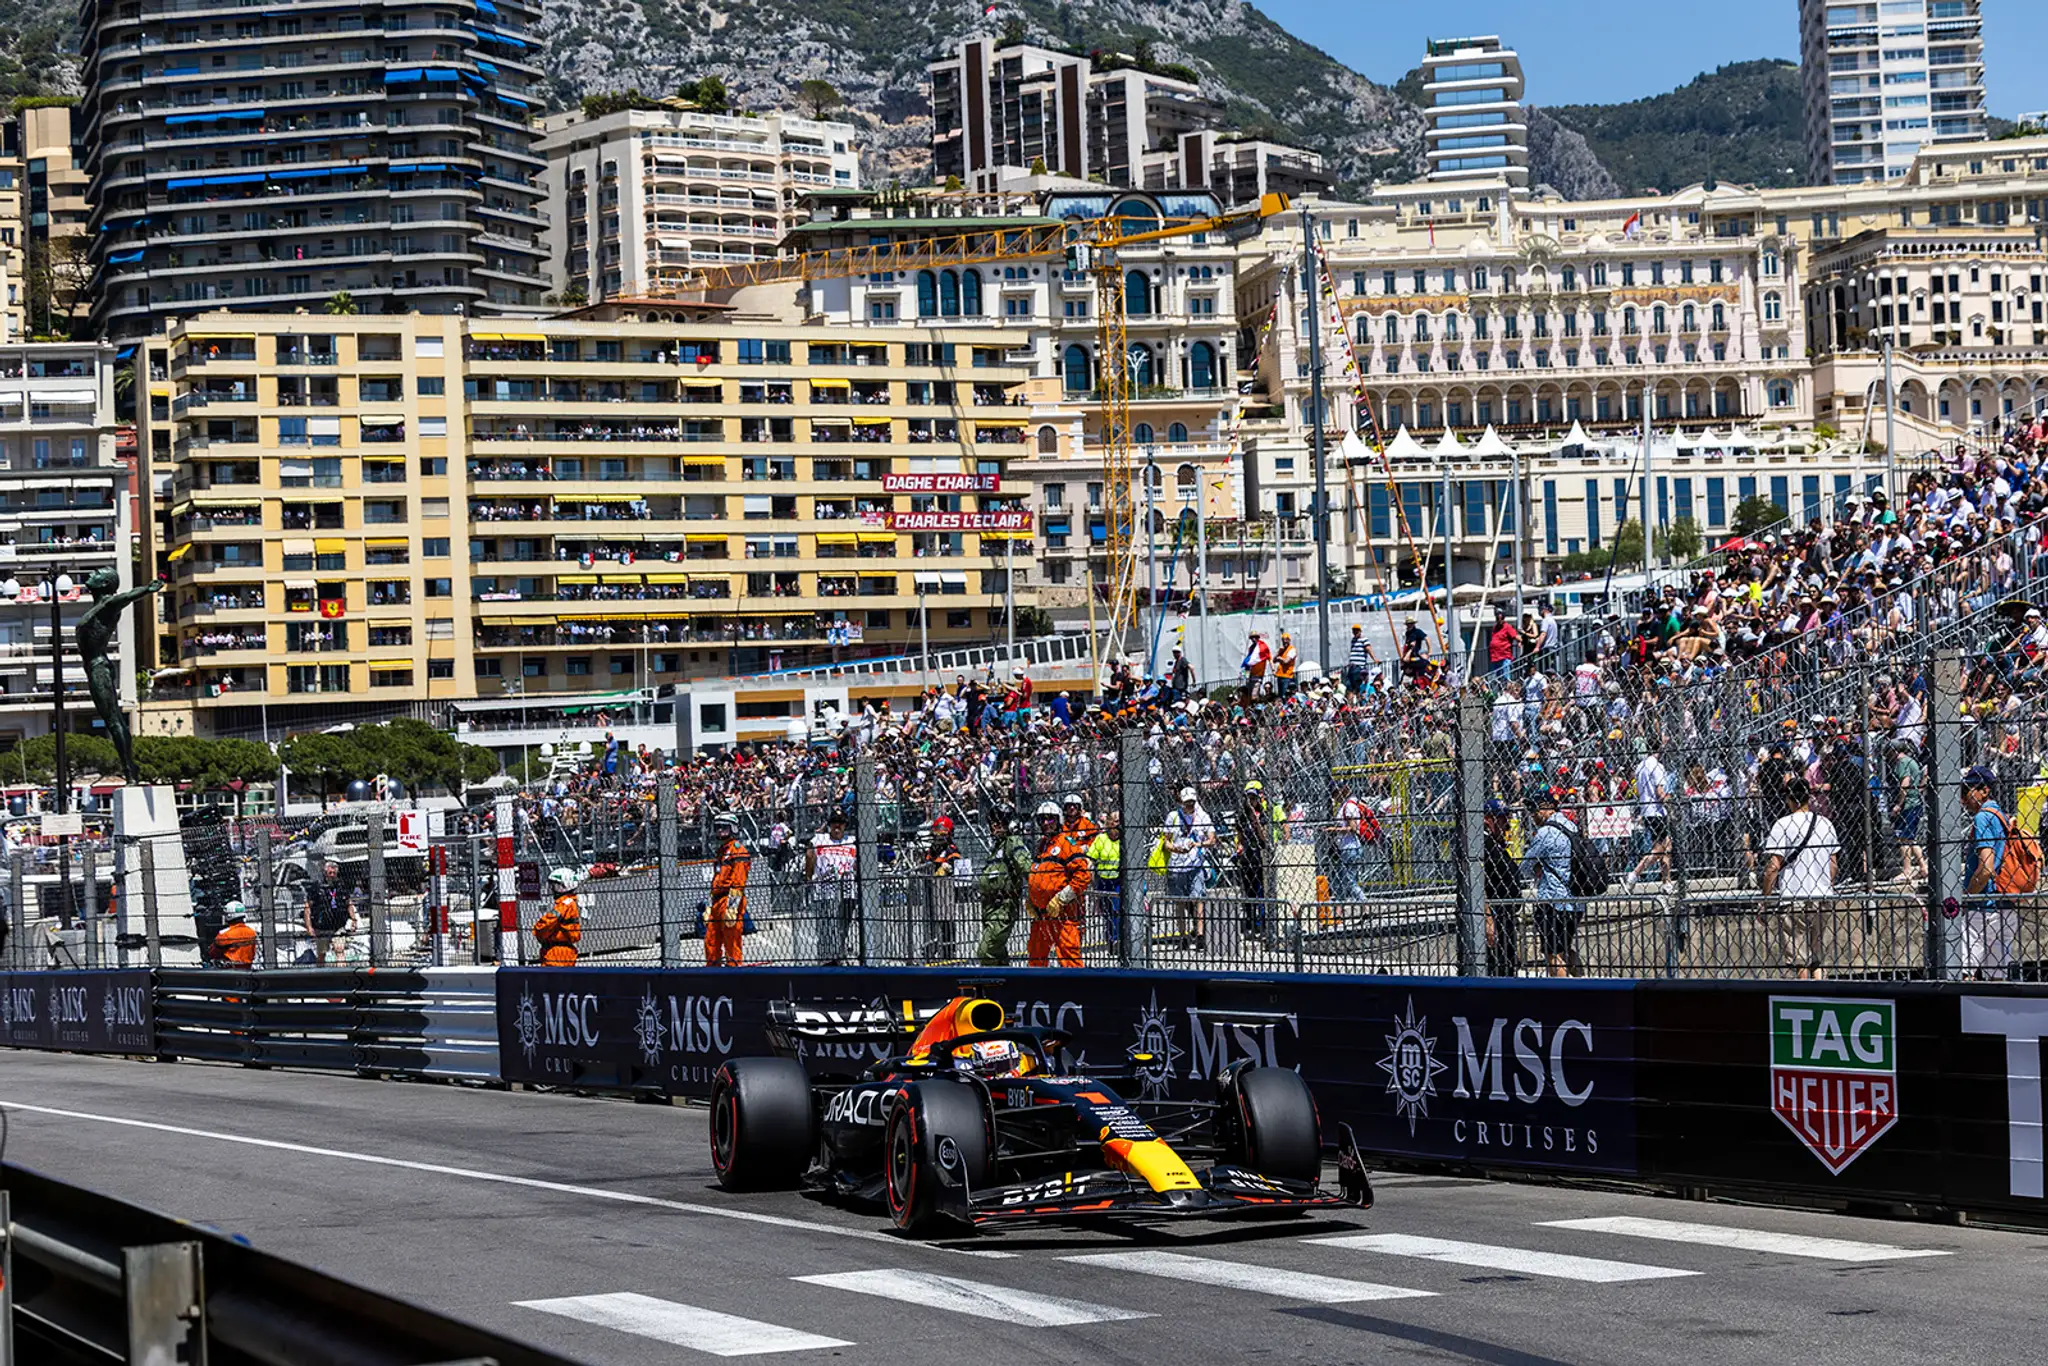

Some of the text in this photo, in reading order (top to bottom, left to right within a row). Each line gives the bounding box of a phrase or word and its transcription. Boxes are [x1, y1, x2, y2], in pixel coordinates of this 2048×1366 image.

[886, 476, 994, 490] DAGHE CHARLIE
[895, 515, 960, 528] CHARLES
[963, 514, 1021, 528] L'ECLAIR
[12, 988, 36, 1022] MSC
[60, 987, 88, 1022] MSC
[117, 987, 146, 1025] MSC
[542, 993, 600, 1047] MSC
[668, 995, 733, 1054] MSC
[1779, 1008, 1884, 1064] TAG
[1452, 1017, 1594, 1107] MSC
[824, 1089, 897, 1126] RACLE
[1007, 1085, 1034, 1107] BYBIT
[1454, 1119, 1598, 1154] CRUISES
[1778, 1076, 1891, 1160] HEUER
